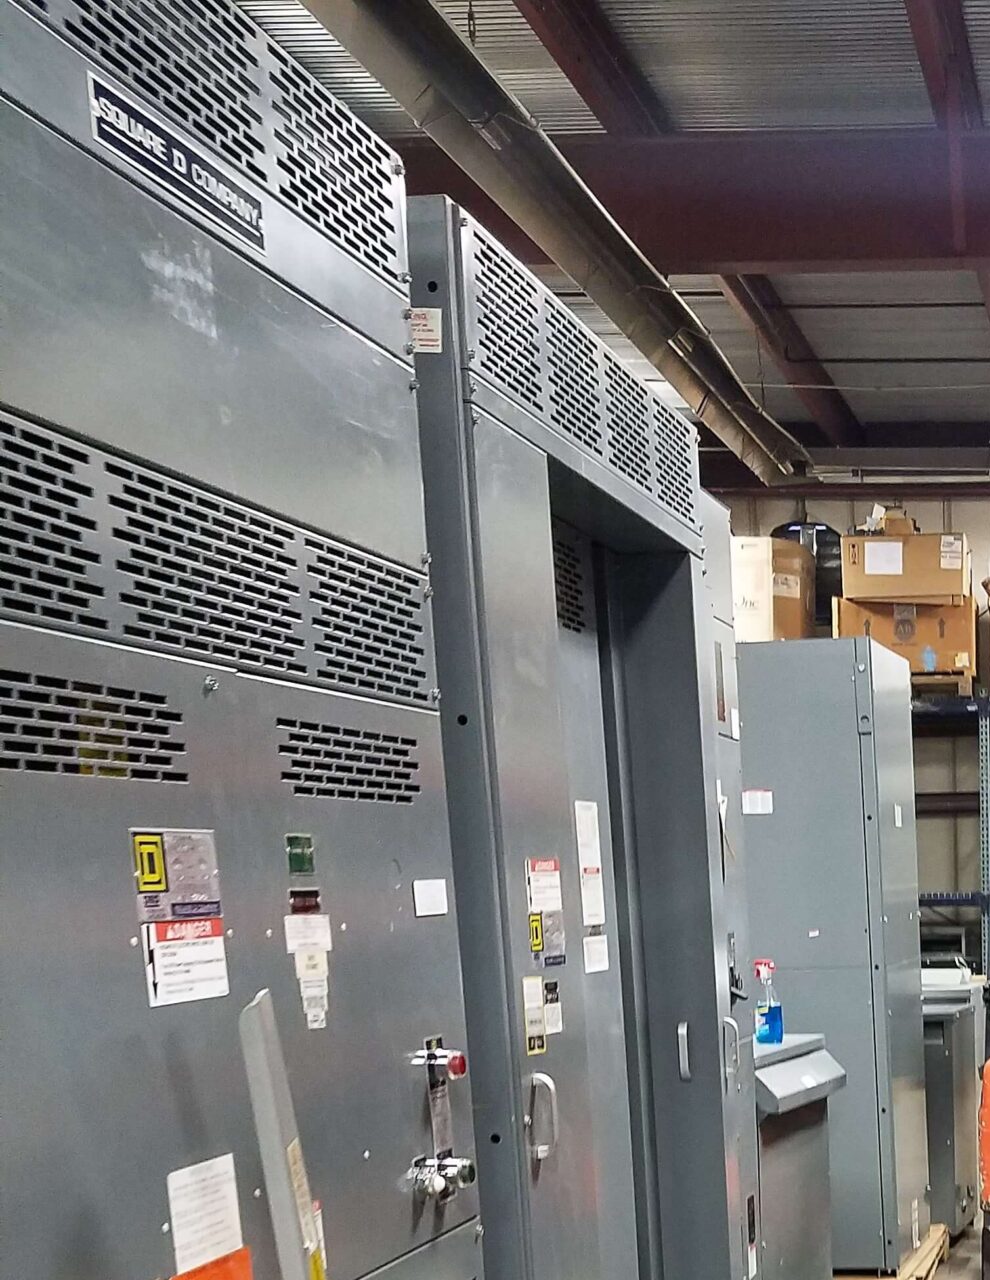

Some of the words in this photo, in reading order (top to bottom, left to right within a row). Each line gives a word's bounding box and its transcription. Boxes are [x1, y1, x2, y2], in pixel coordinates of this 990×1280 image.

[99, 96, 168, 161] SQUARE
[172, 147, 187, 174] D
[191, 162, 259, 226] COMPANY
